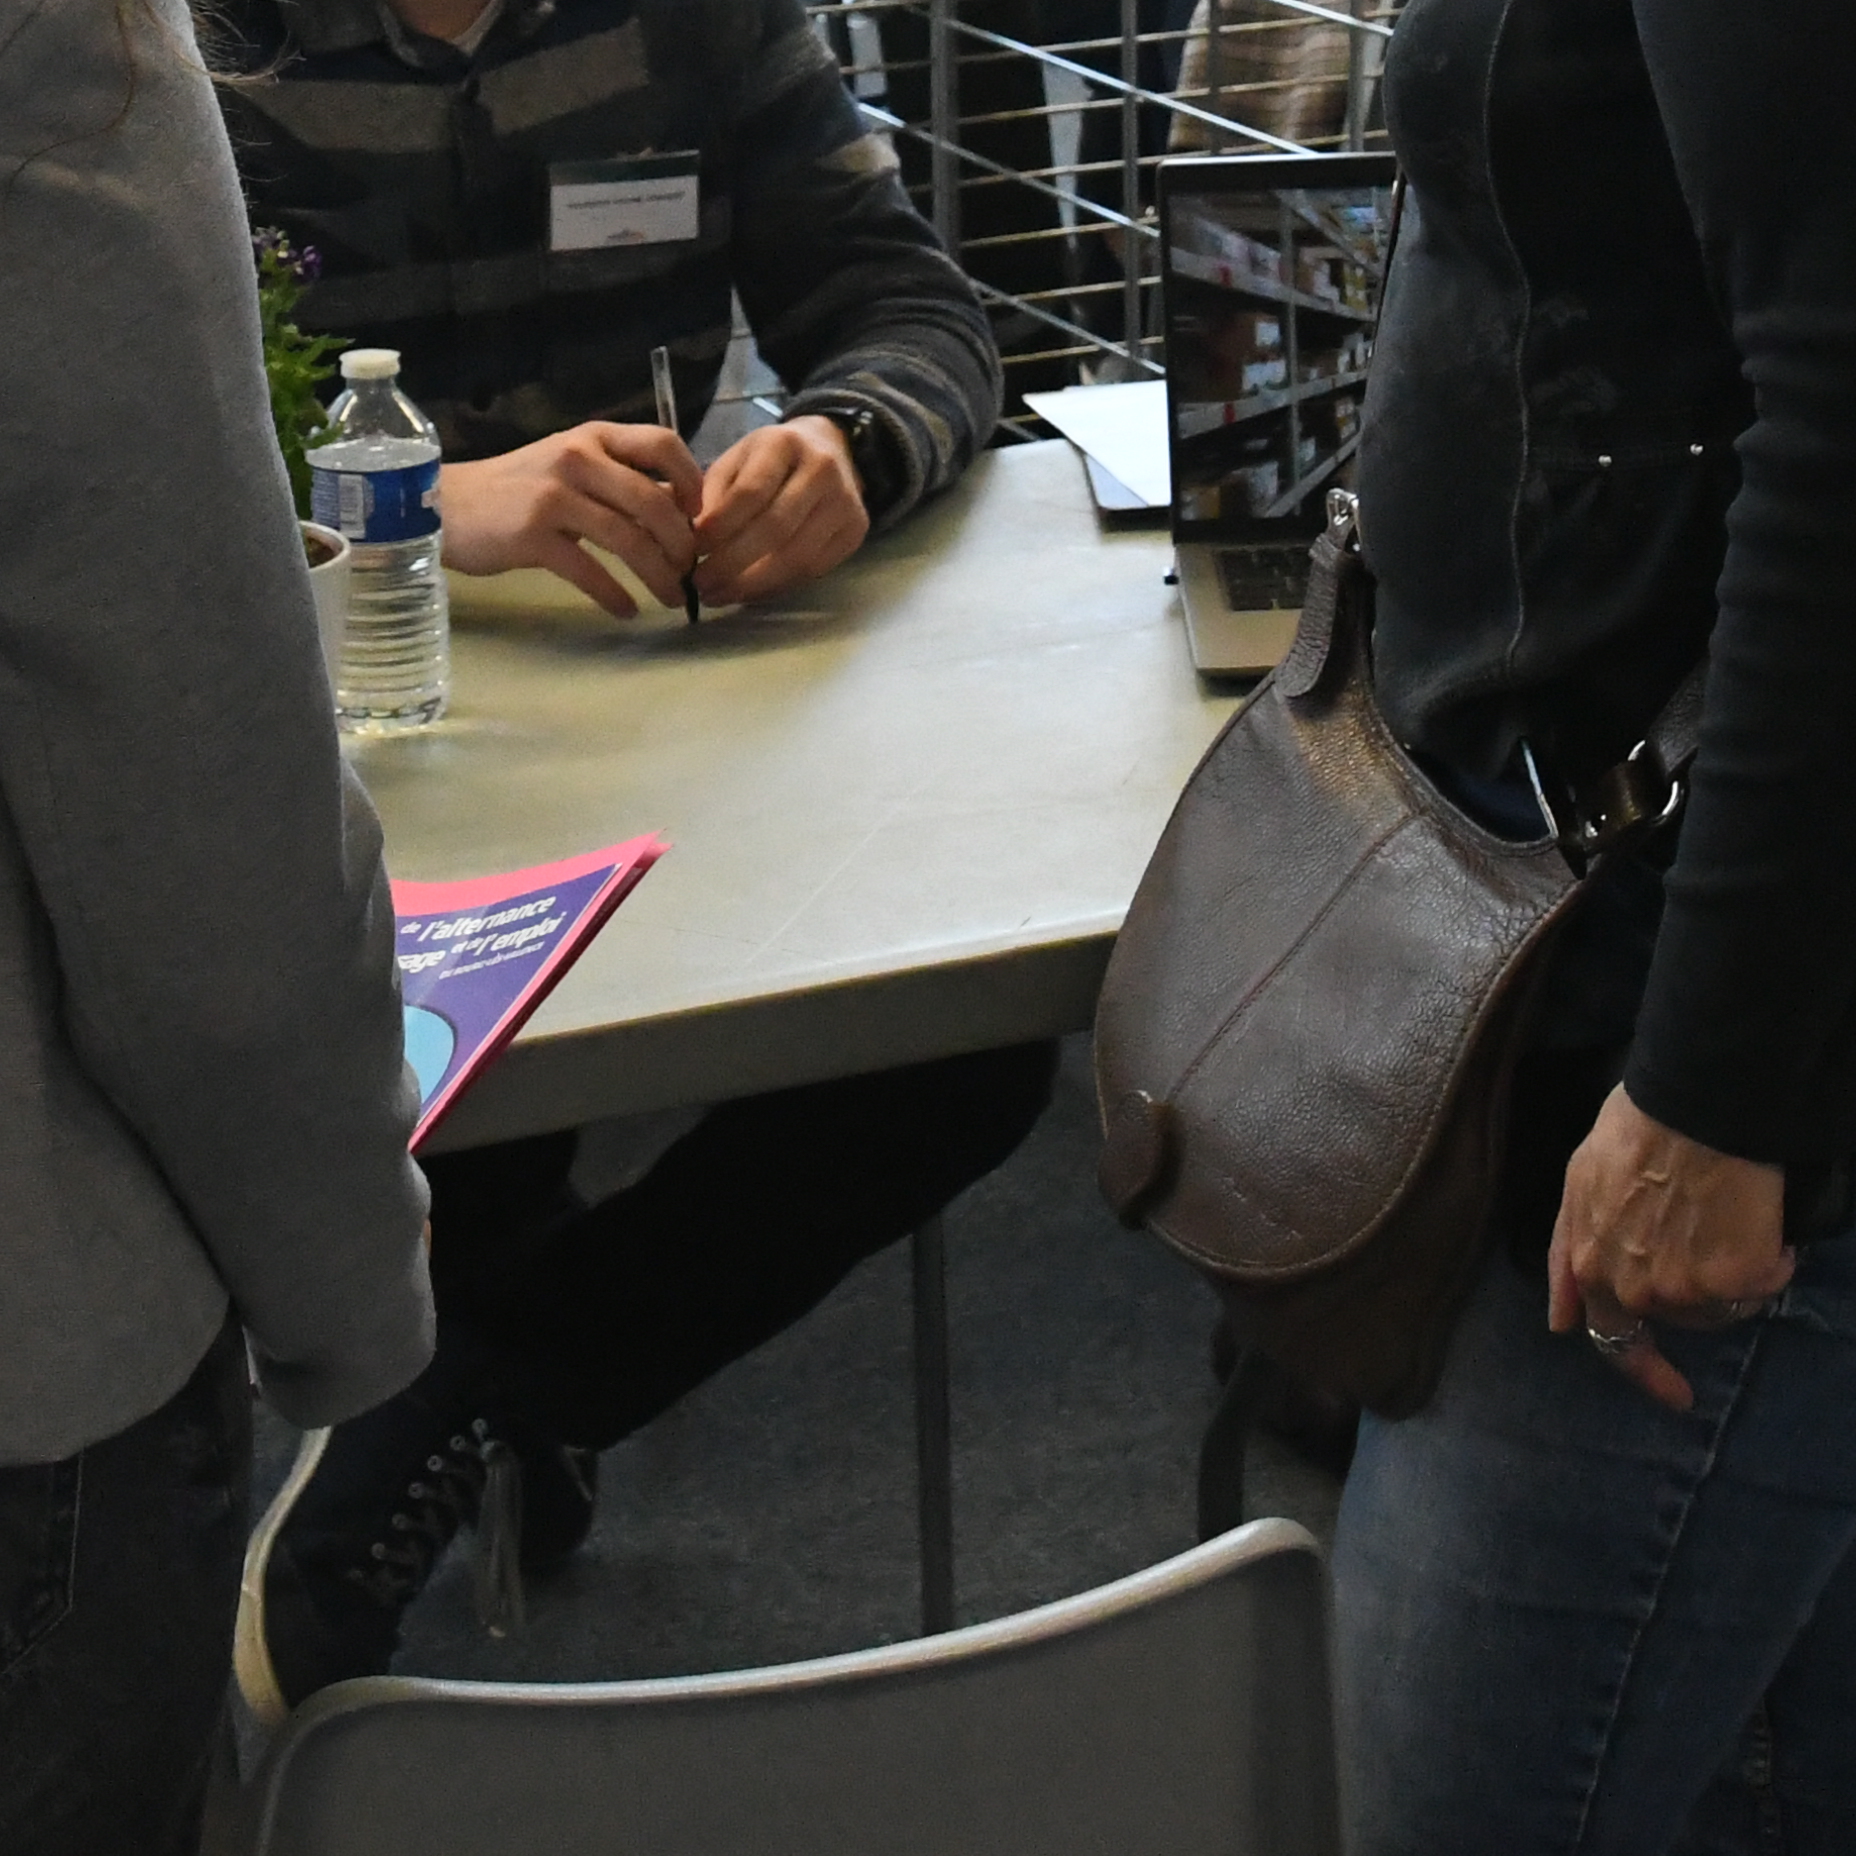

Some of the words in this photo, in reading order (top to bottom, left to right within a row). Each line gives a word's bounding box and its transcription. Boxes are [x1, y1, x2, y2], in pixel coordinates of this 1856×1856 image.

[400, 921, 422, 934] de
[416, 895, 557, 942] l'alternance
[473, 910, 568, 957] l'emploi
